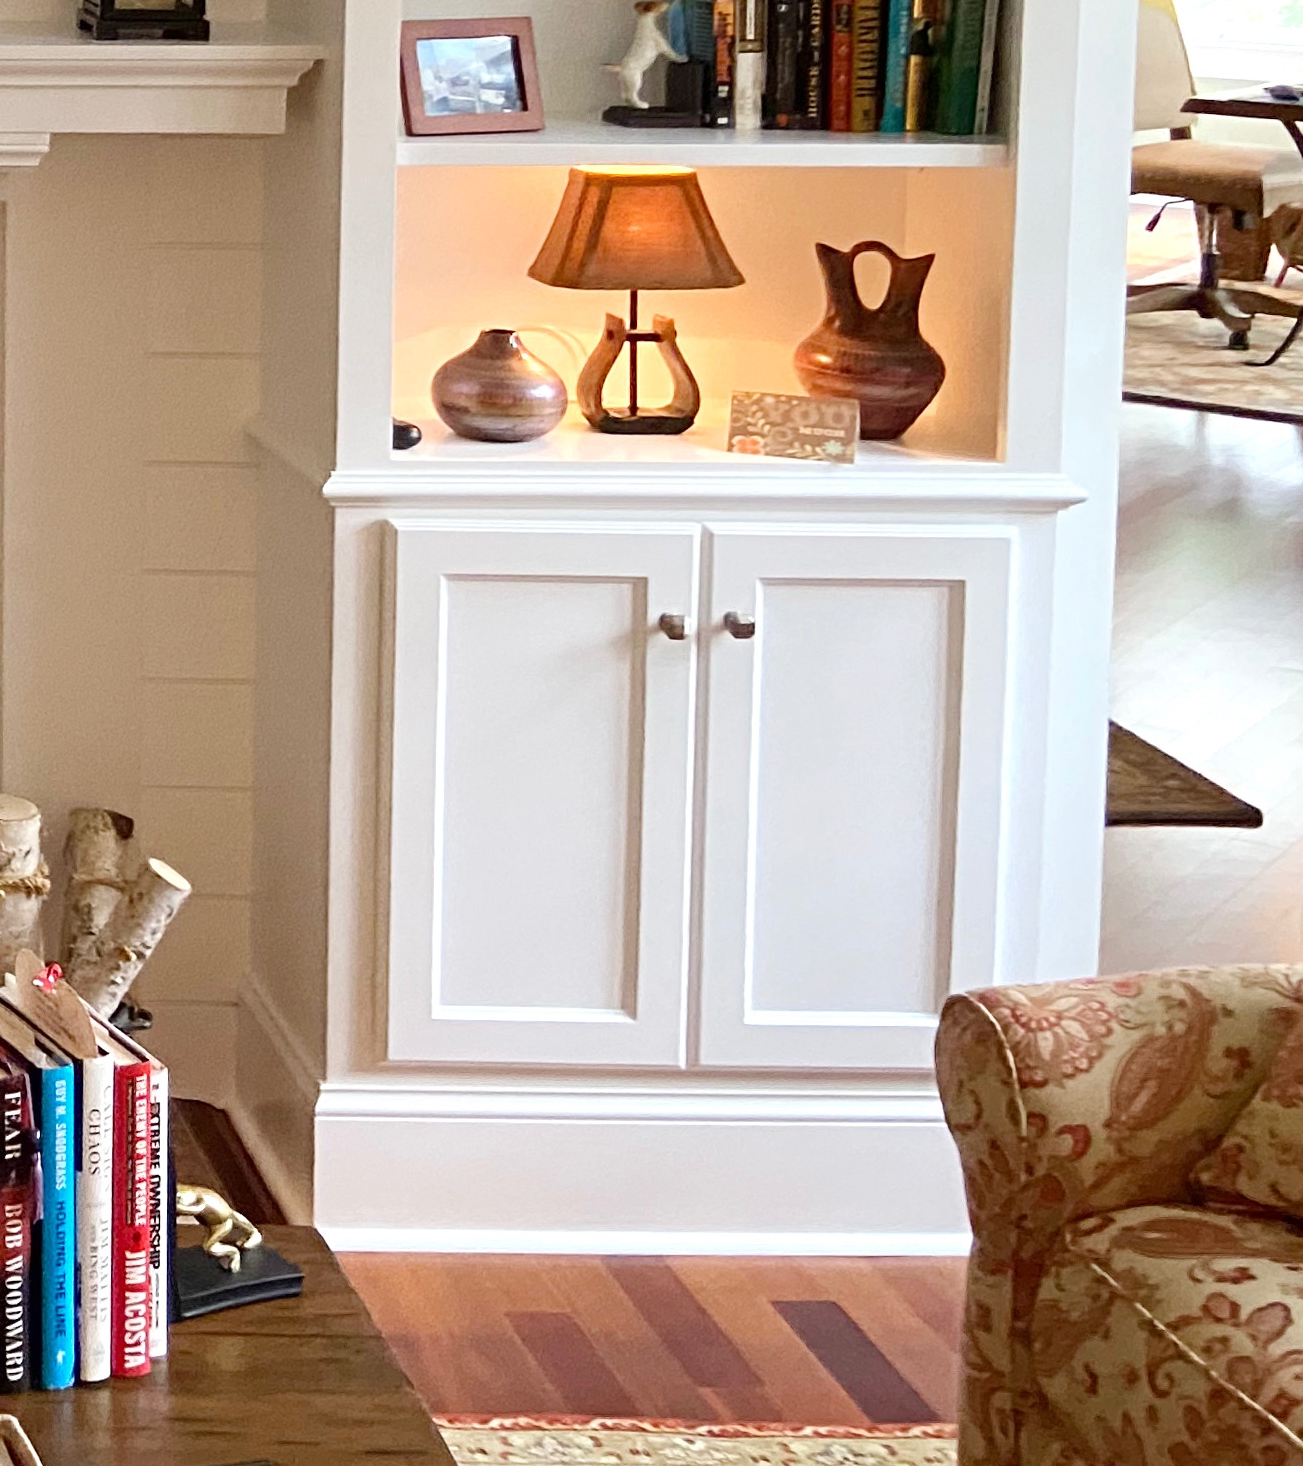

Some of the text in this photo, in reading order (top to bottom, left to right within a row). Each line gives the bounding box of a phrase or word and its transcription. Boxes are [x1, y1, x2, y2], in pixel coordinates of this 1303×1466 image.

[55, 1080, 66, 1102] GUY
[5, 1092, 22, 1160] FEAR
[56, 1123, 66, 1190] SNODGRASS
[88, 1108, 102, 1175] CHAOS
[135, 1074, 147, 1226] THE ENEMY OF THE PEOPLE
[151, 1102, 160, 1170] EXTREME
[150, 1174, 161, 1270] OWNERSHIP
[5, 1204, 24, 1382] BOB WOODWARD
[55, 1201, 66, 1338] HOLDING THE LINE
[89, 1246, 98, 1278] BING
[124, 1250, 146, 1368] JIM ACOSTA
